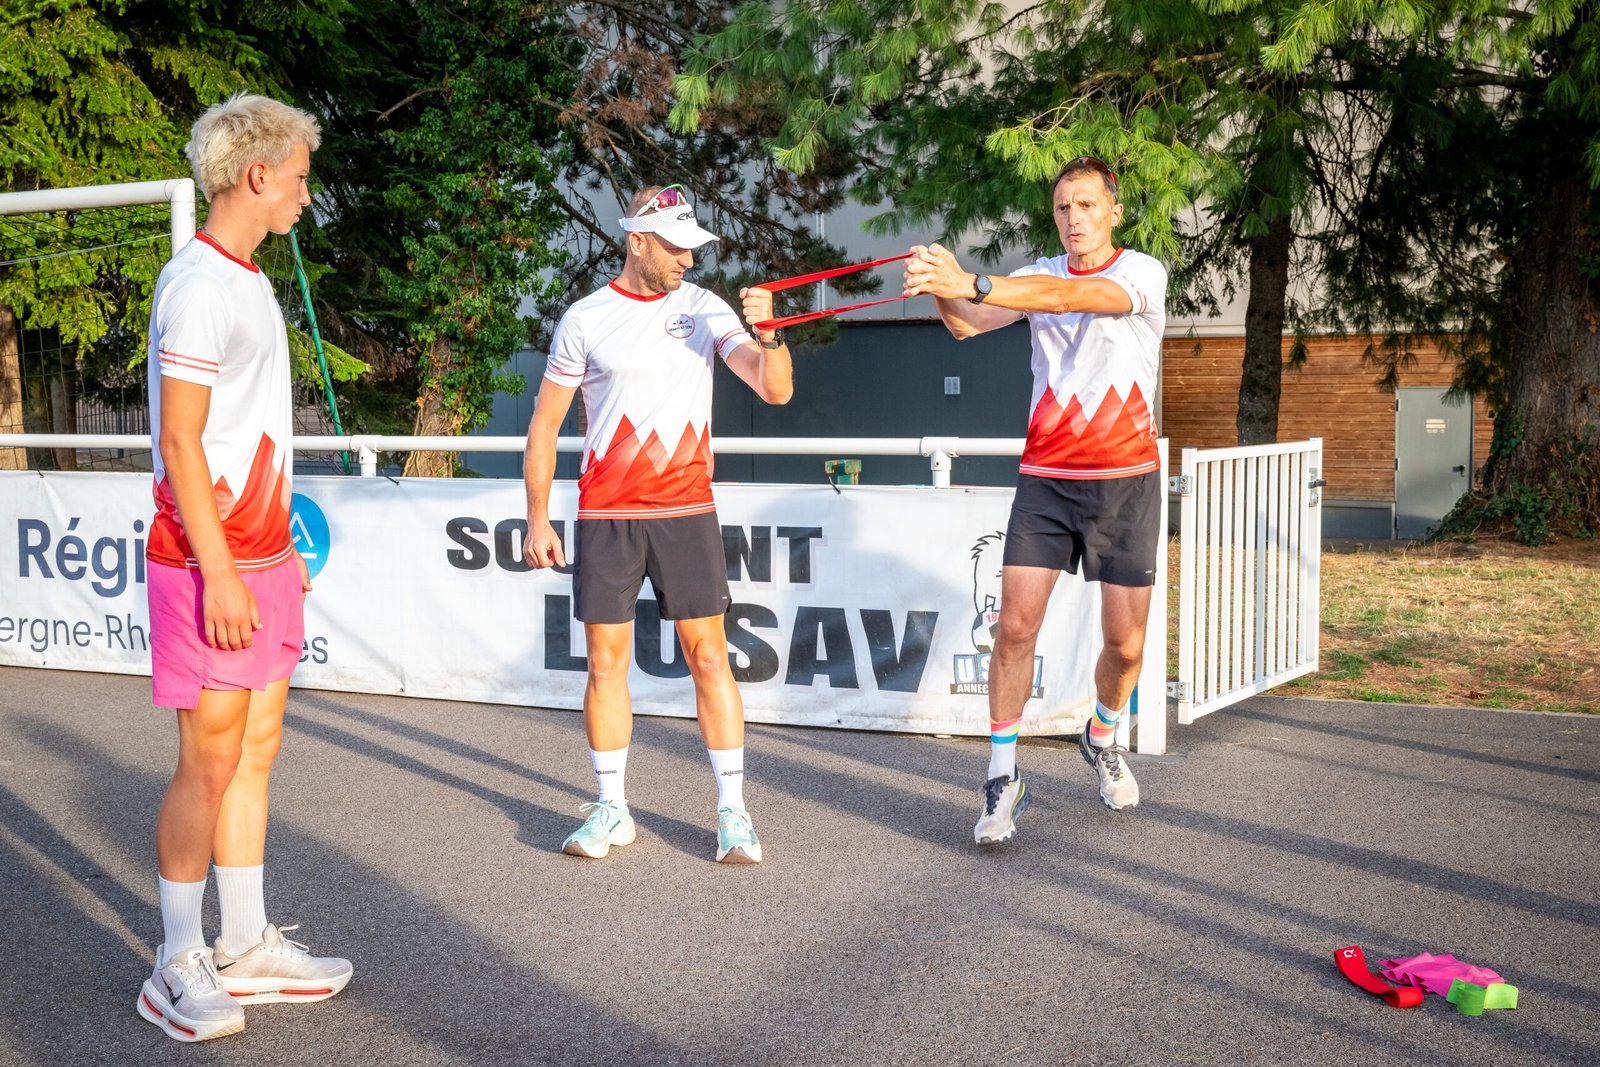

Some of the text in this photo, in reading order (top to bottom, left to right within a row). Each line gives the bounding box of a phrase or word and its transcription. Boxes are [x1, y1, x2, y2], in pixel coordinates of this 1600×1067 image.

[17, 517, 145, 598] Régi
[446, 516, 823, 584] SOUNT
[544, 594, 939, 694] LUSAV
